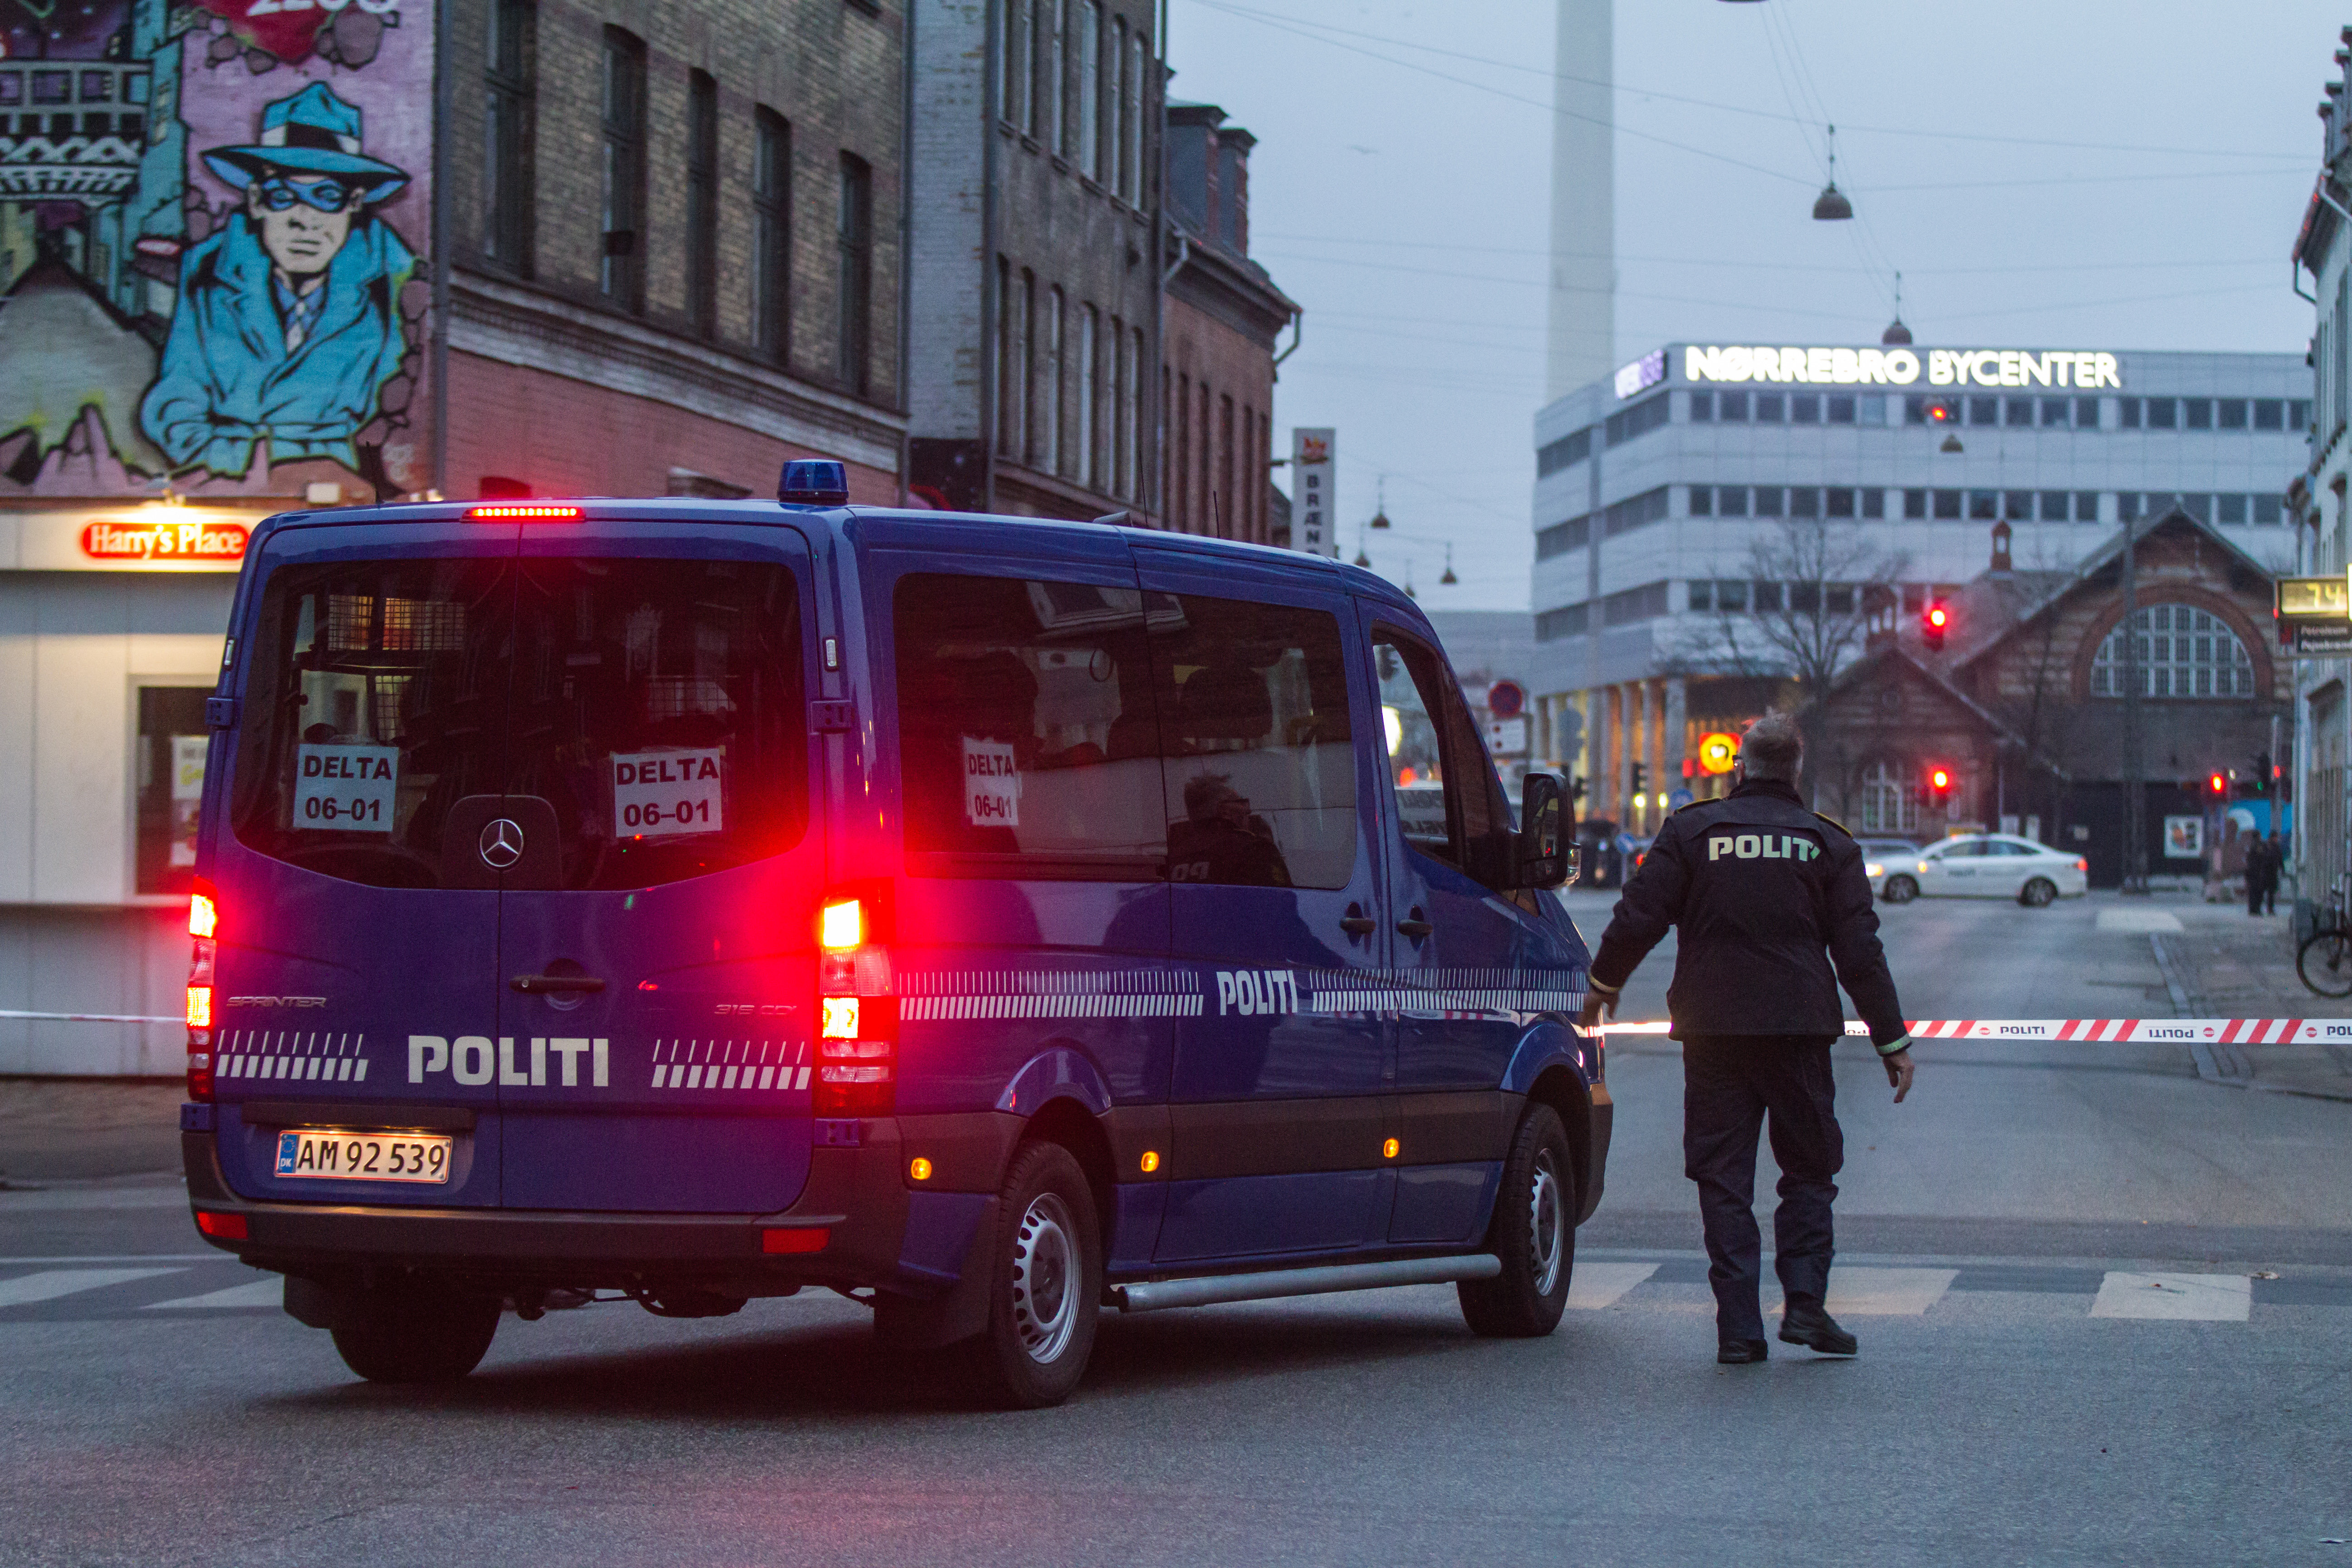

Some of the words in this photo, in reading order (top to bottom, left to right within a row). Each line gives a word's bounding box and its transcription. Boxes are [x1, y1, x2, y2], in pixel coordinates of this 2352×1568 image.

[1686, 346, 1920, 384] NØRREBRO
[1929, 350, 2120, 388] BYCENTER
[89, 525, 173, 559] Harry's
[178, 524, 244, 553] Place
[303, 755, 392, 780] DELTA
[616, 757, 719, 785] DELTA
[968, 754, 1014, 777] DELTA
[226, 996, 327, 1008] SPRINTER
[1216, 970, 1298, 1015] POLITI
[2149, 1029, 2194, 1038] POLITI
[408, 1034, 609, 1087] POLITI
[280, 1157, 292, 1168] DK
[297, 1140, 339, 1170] AM
[346, 1141, 381, 1172] 92
[388, 1143, 445, 1176] 539
